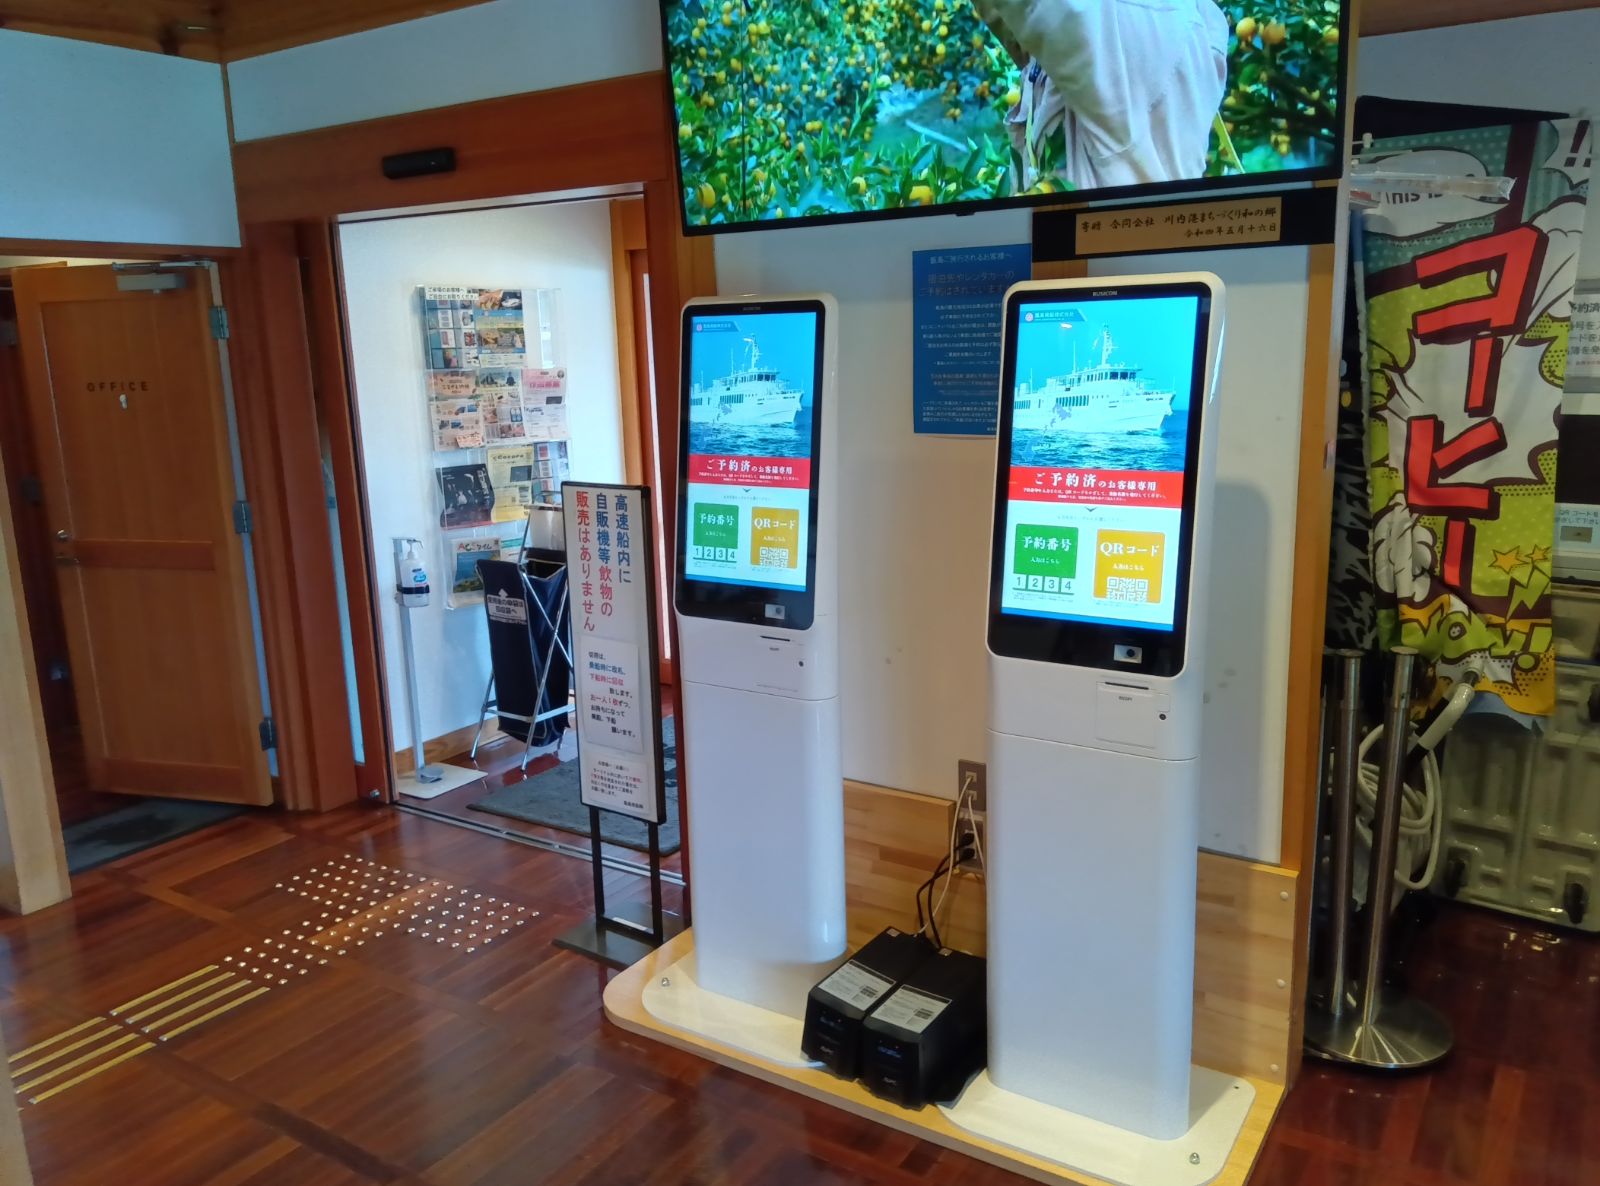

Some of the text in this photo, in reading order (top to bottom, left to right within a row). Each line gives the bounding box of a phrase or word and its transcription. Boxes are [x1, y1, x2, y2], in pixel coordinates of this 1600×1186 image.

[1109, 216, 1155, 230] 合同会社
[1184, 222, 1277, 239] 令和四年五月十六日
[86, 381, 150, 392] OFFICE
[706, 459, 793, 475] ご予約済のお客様専用
[1035, 472, 1157, 491] ご予約済のお客様専用
[700, 513, 735, 526] 予約番号
[754, 517, 796, 530] QRコード
[614, 493, 631, 584] 高速船内に
[1022, 535, 1073, 552] 予約番号
[595, 492, 613, 617] 自販機等飲物の
[1100, 543, 1160, 557] QRコード
[576, 490, 595, 632] 販売はありません
[589, 672, 624, 687] 下船時に回収
[591, 704, 626, 718] お持ちになって
